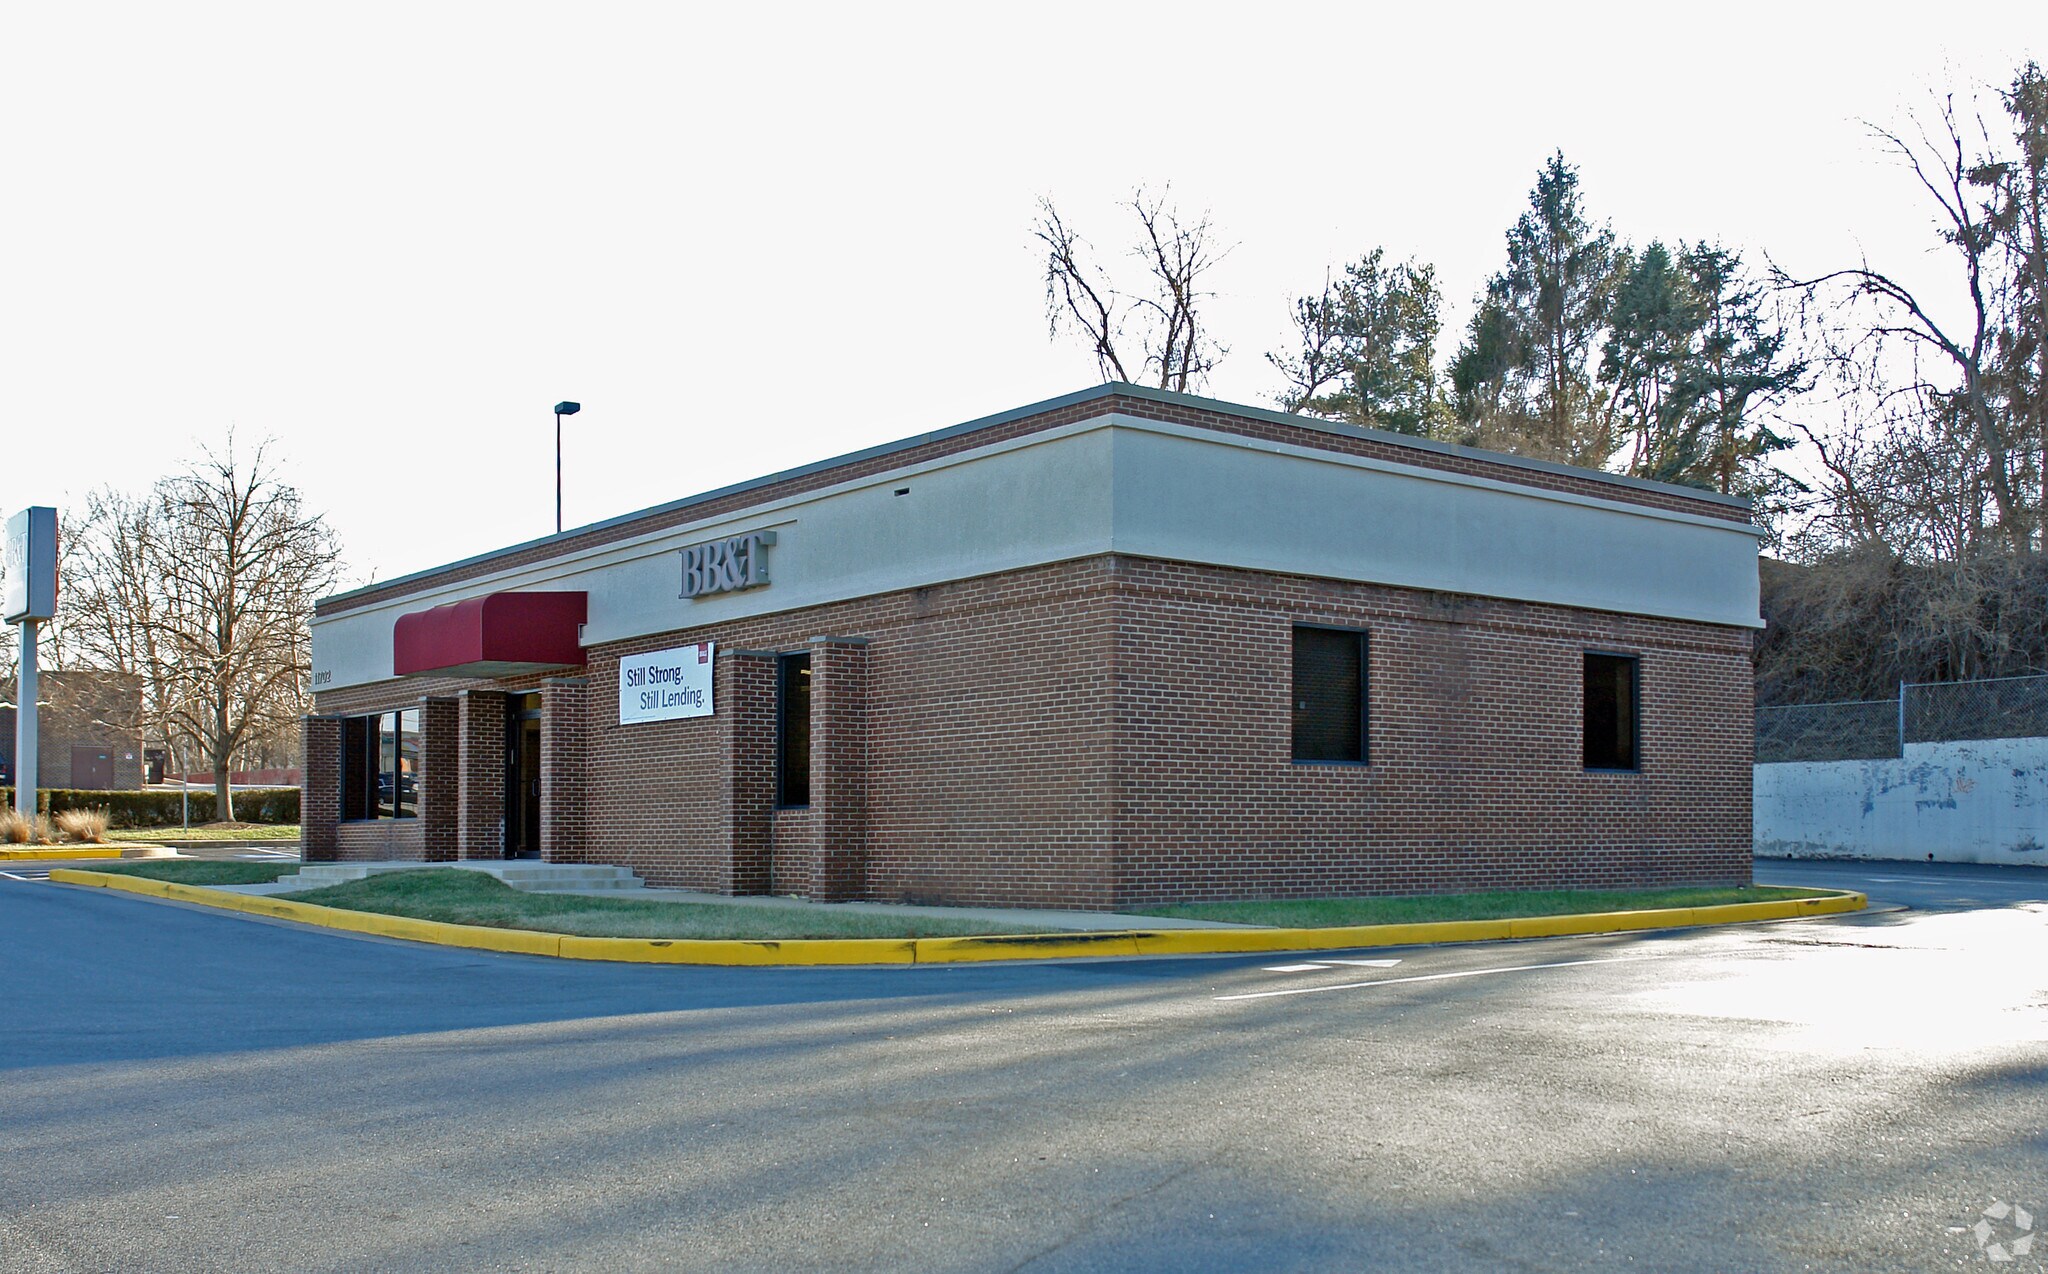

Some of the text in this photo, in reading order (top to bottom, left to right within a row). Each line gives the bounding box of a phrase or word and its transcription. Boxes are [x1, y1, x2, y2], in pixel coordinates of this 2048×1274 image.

[678, 530, 777, 599] BB&T
[627, 666, 684, 687] Still Strong.
[640, 686, 705, 710] Still Lending.
